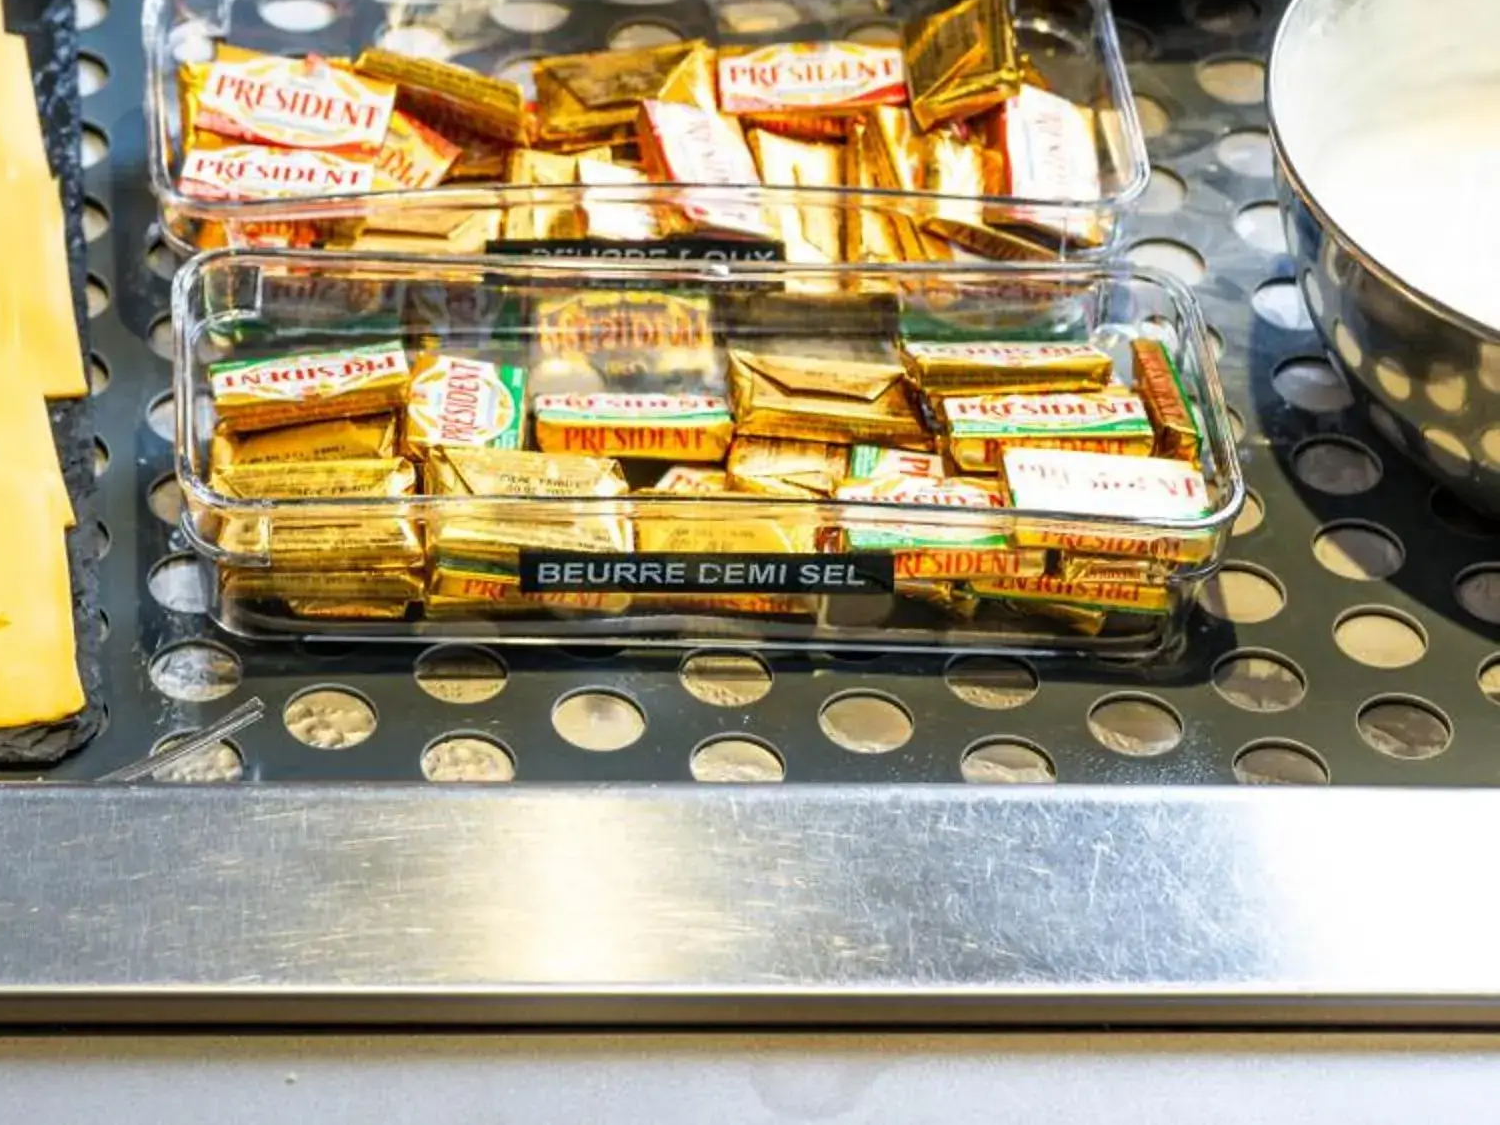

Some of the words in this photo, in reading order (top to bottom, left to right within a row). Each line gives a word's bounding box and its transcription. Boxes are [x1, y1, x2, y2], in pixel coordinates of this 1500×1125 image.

[537, 562, 686, 585] BEURRE
[698, 563, 788, 586] DEMI
[799, 564, 867, 586] SEL
